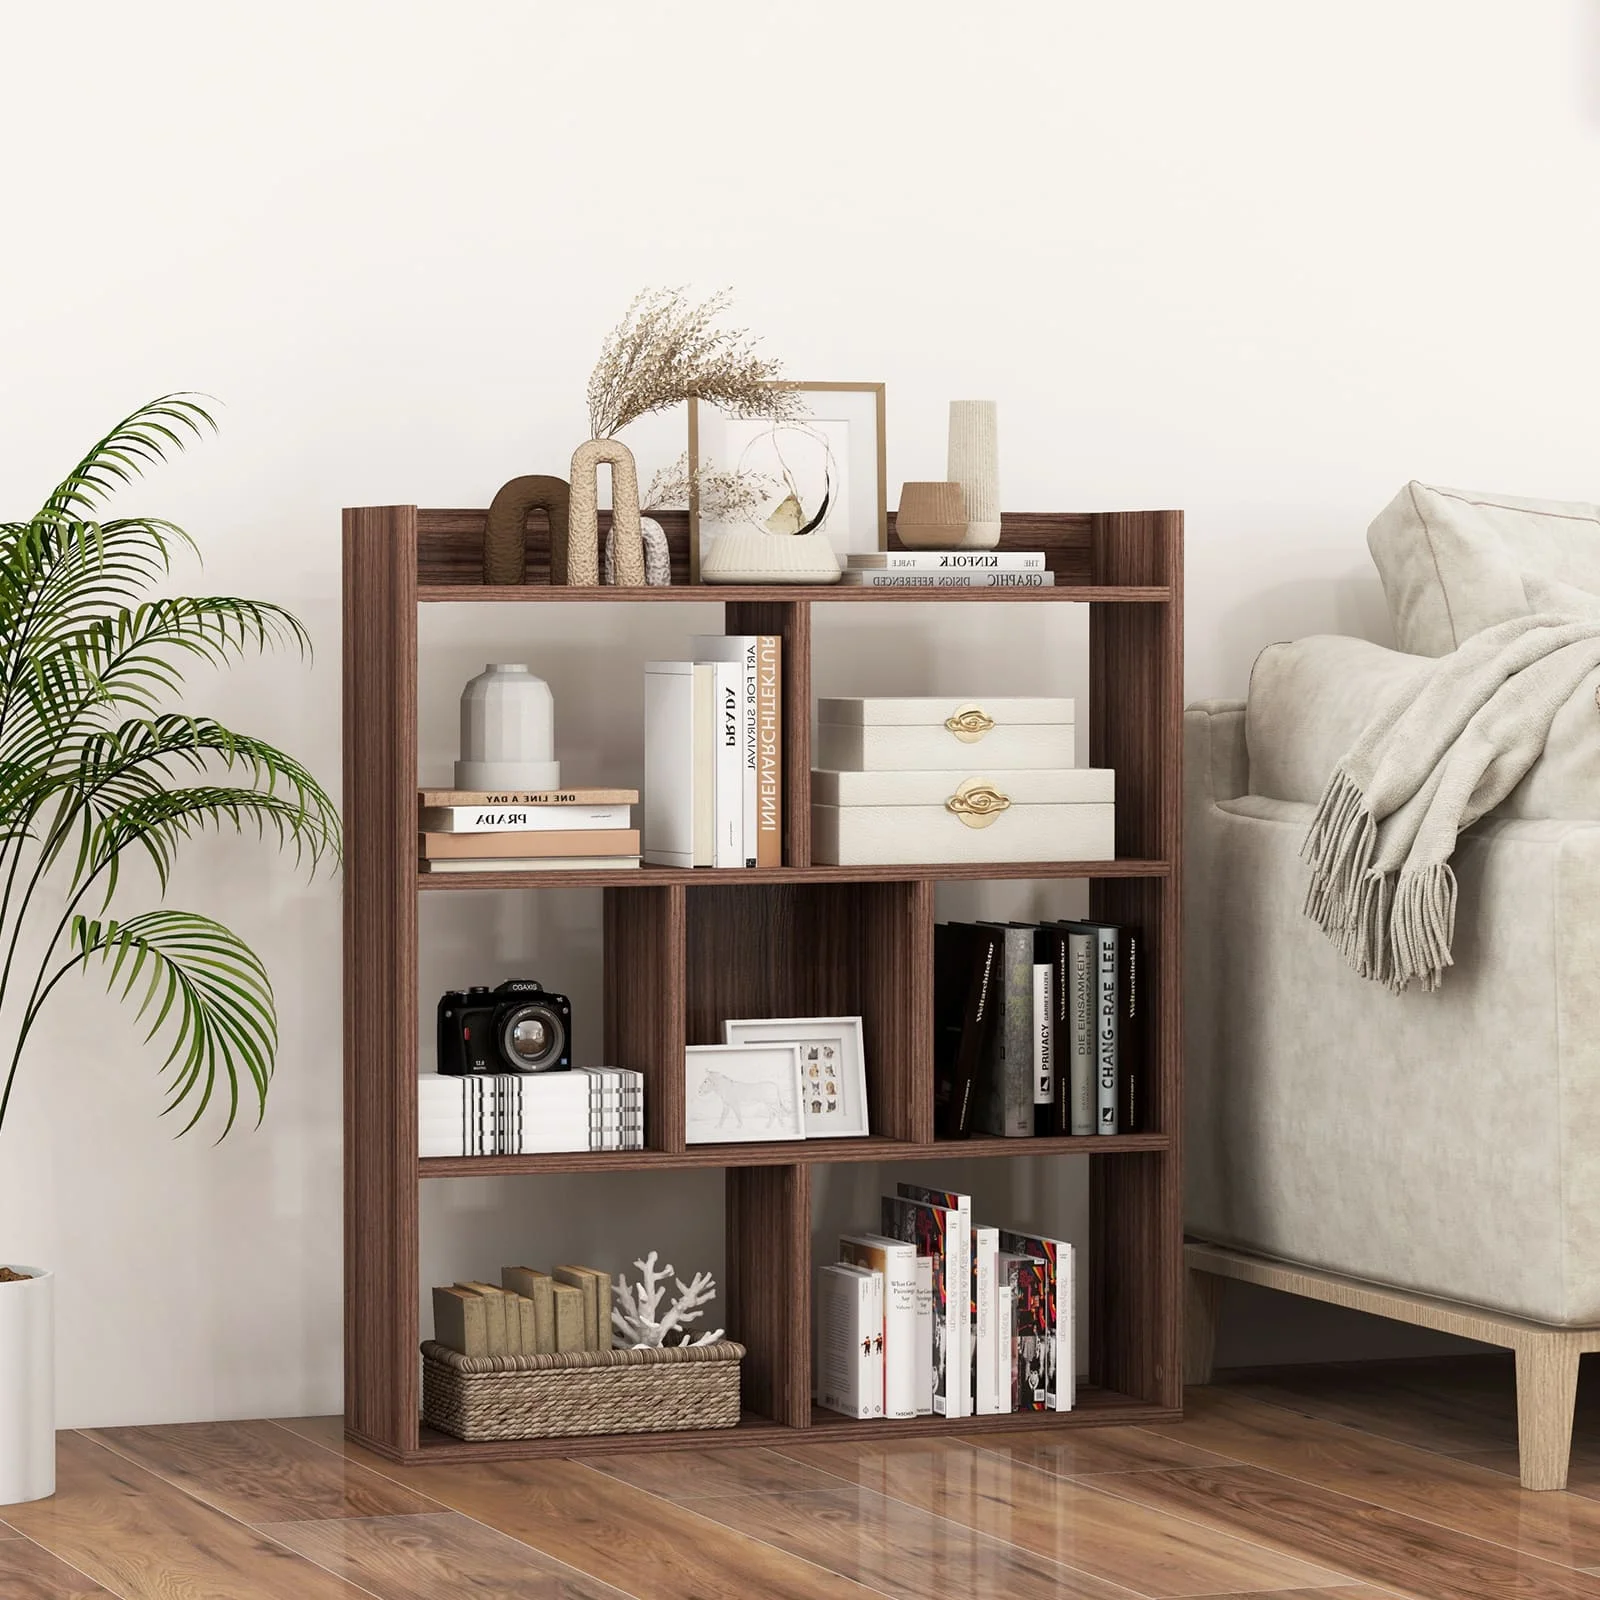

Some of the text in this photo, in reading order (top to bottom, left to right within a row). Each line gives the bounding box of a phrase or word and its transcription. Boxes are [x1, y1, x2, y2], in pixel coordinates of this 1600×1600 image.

[975, 941, 995, 1022] Weltarchitektur
[1077, 951, 1086, 1056] DIE EINSAMKEIT
[1102, 941, 1115, 1089] CHANG-RAE LEE
[1041, 1023, 1049, 1071] PRIVACY
